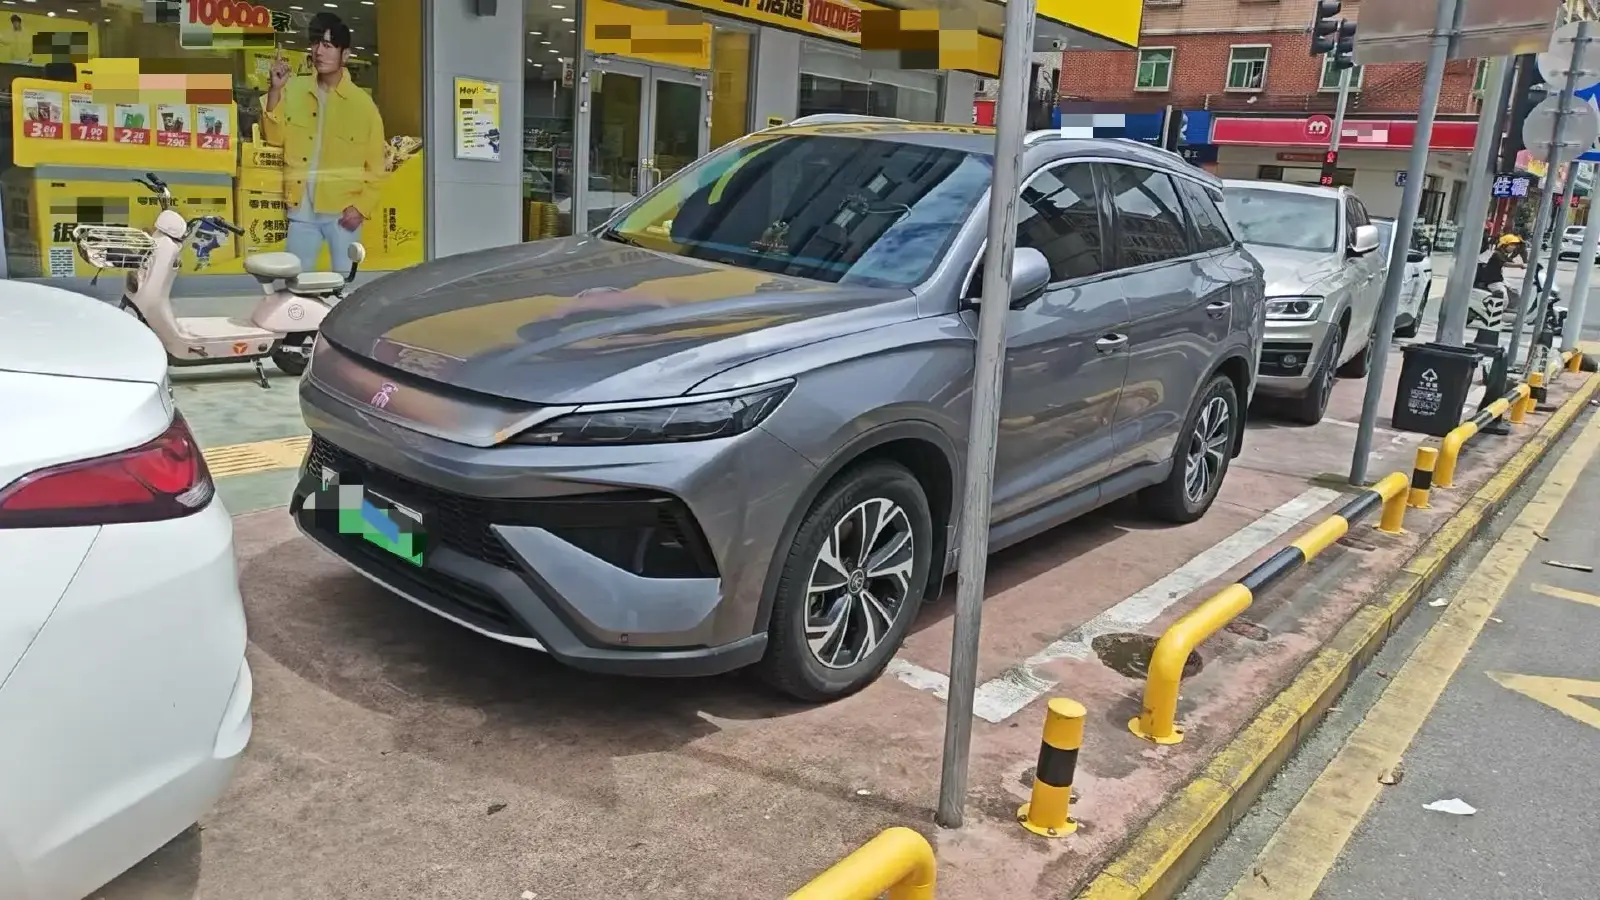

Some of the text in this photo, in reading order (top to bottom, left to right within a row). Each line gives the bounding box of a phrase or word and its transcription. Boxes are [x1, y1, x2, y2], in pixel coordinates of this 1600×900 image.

[1493, 176, 1530, 196] 住宿
[137, 196, 179, 206] 零食忙
[264, 232, 288, 243] 全国
